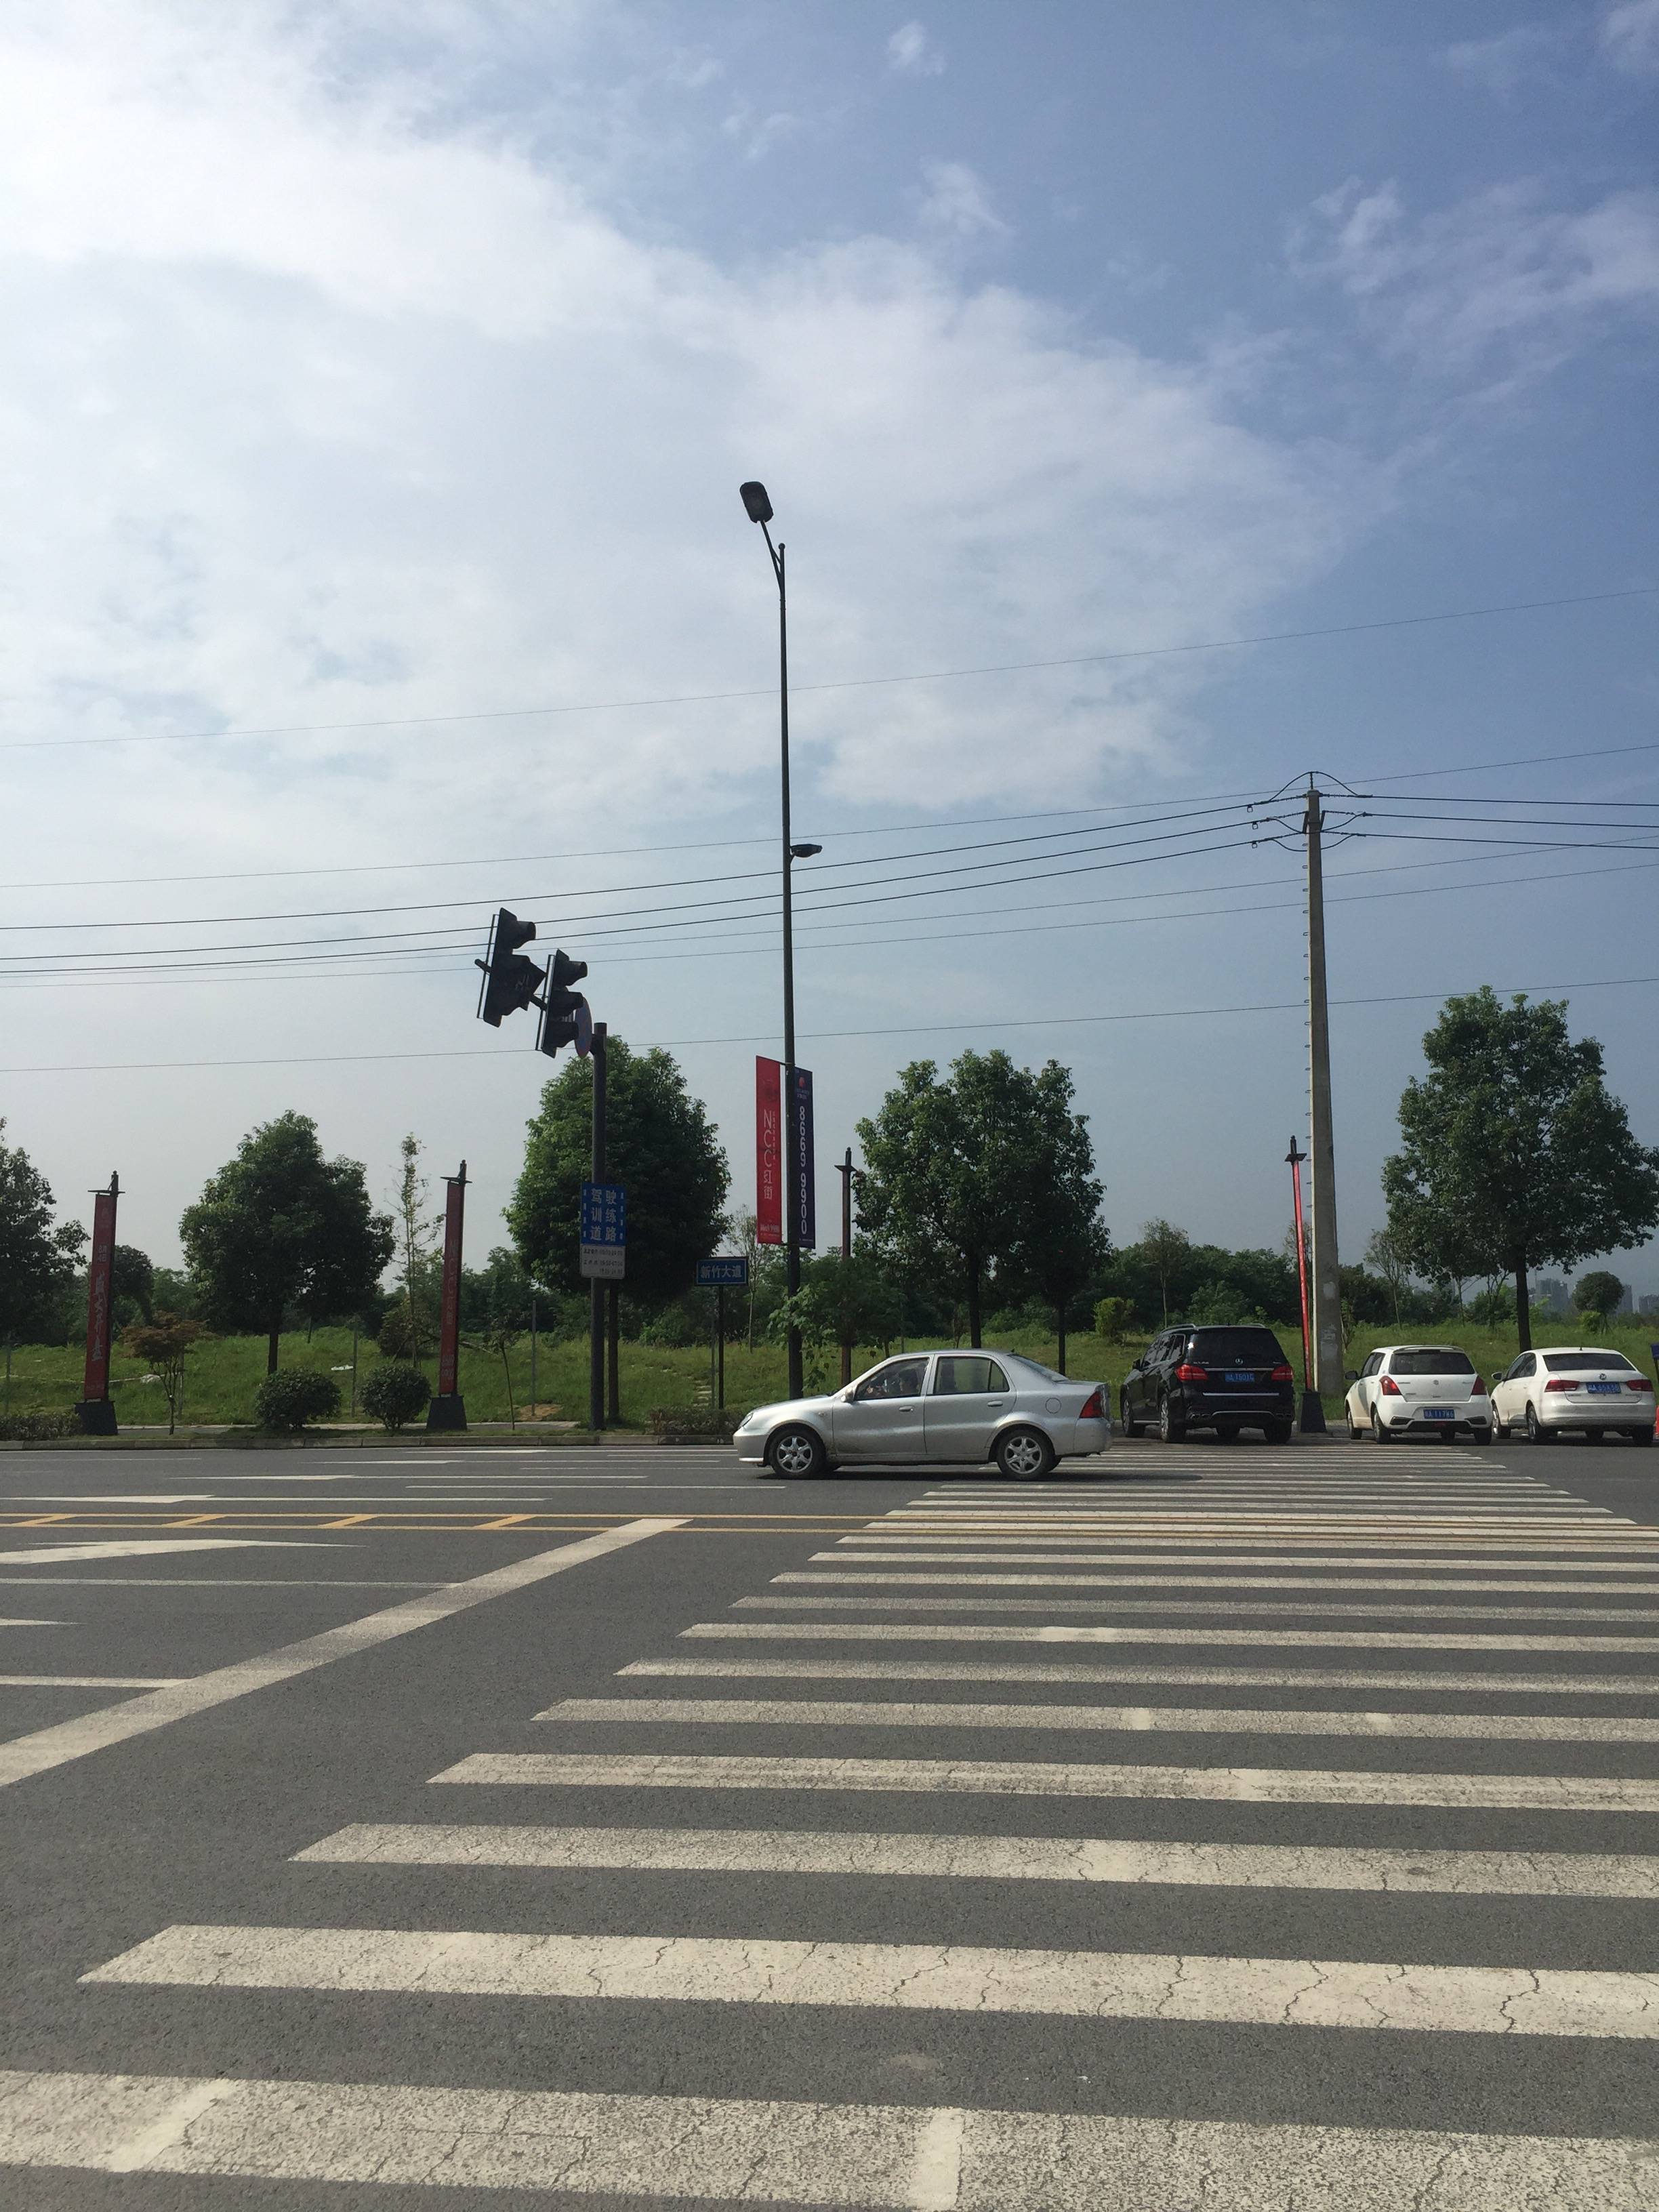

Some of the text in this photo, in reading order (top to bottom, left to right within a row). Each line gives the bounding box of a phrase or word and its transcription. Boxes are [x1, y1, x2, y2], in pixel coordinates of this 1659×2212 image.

[590, 1188, 617, 1205] 驾驶
[590, 1206, 617, 1223] 训练
[590, 1225, 617, 1242] 道路
[700, 1265, 743, 1279] 新竹大道
